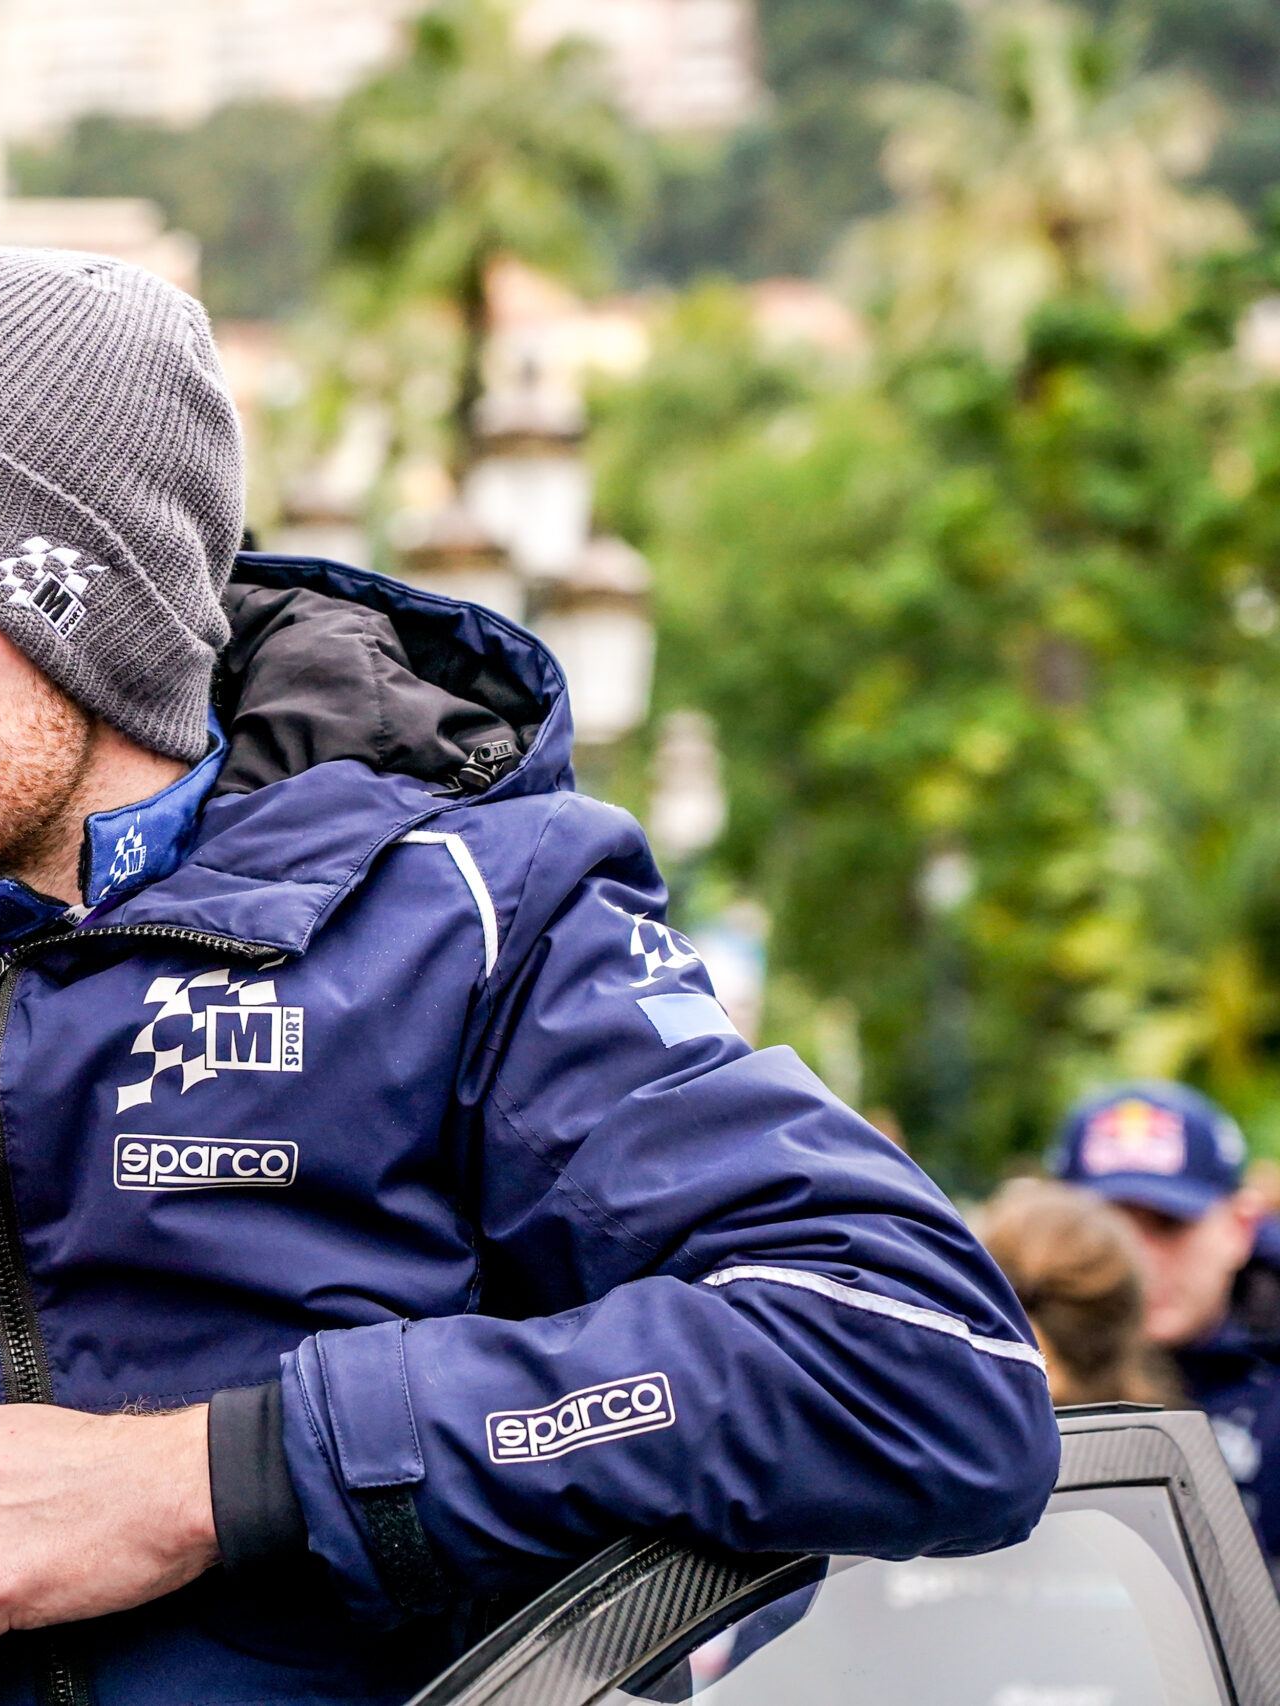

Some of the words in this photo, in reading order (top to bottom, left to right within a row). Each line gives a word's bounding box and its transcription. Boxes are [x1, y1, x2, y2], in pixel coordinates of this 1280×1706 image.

[32, 577, 74, 624] M
[60, 605, 83, 636] SPORT
[215, 1011, 273, 1064] M
[284, 1010, 300, 1066] SPORT
[121, 1142, 290, 1186] sparco
[495, 1382, 663, 1456] sparco
